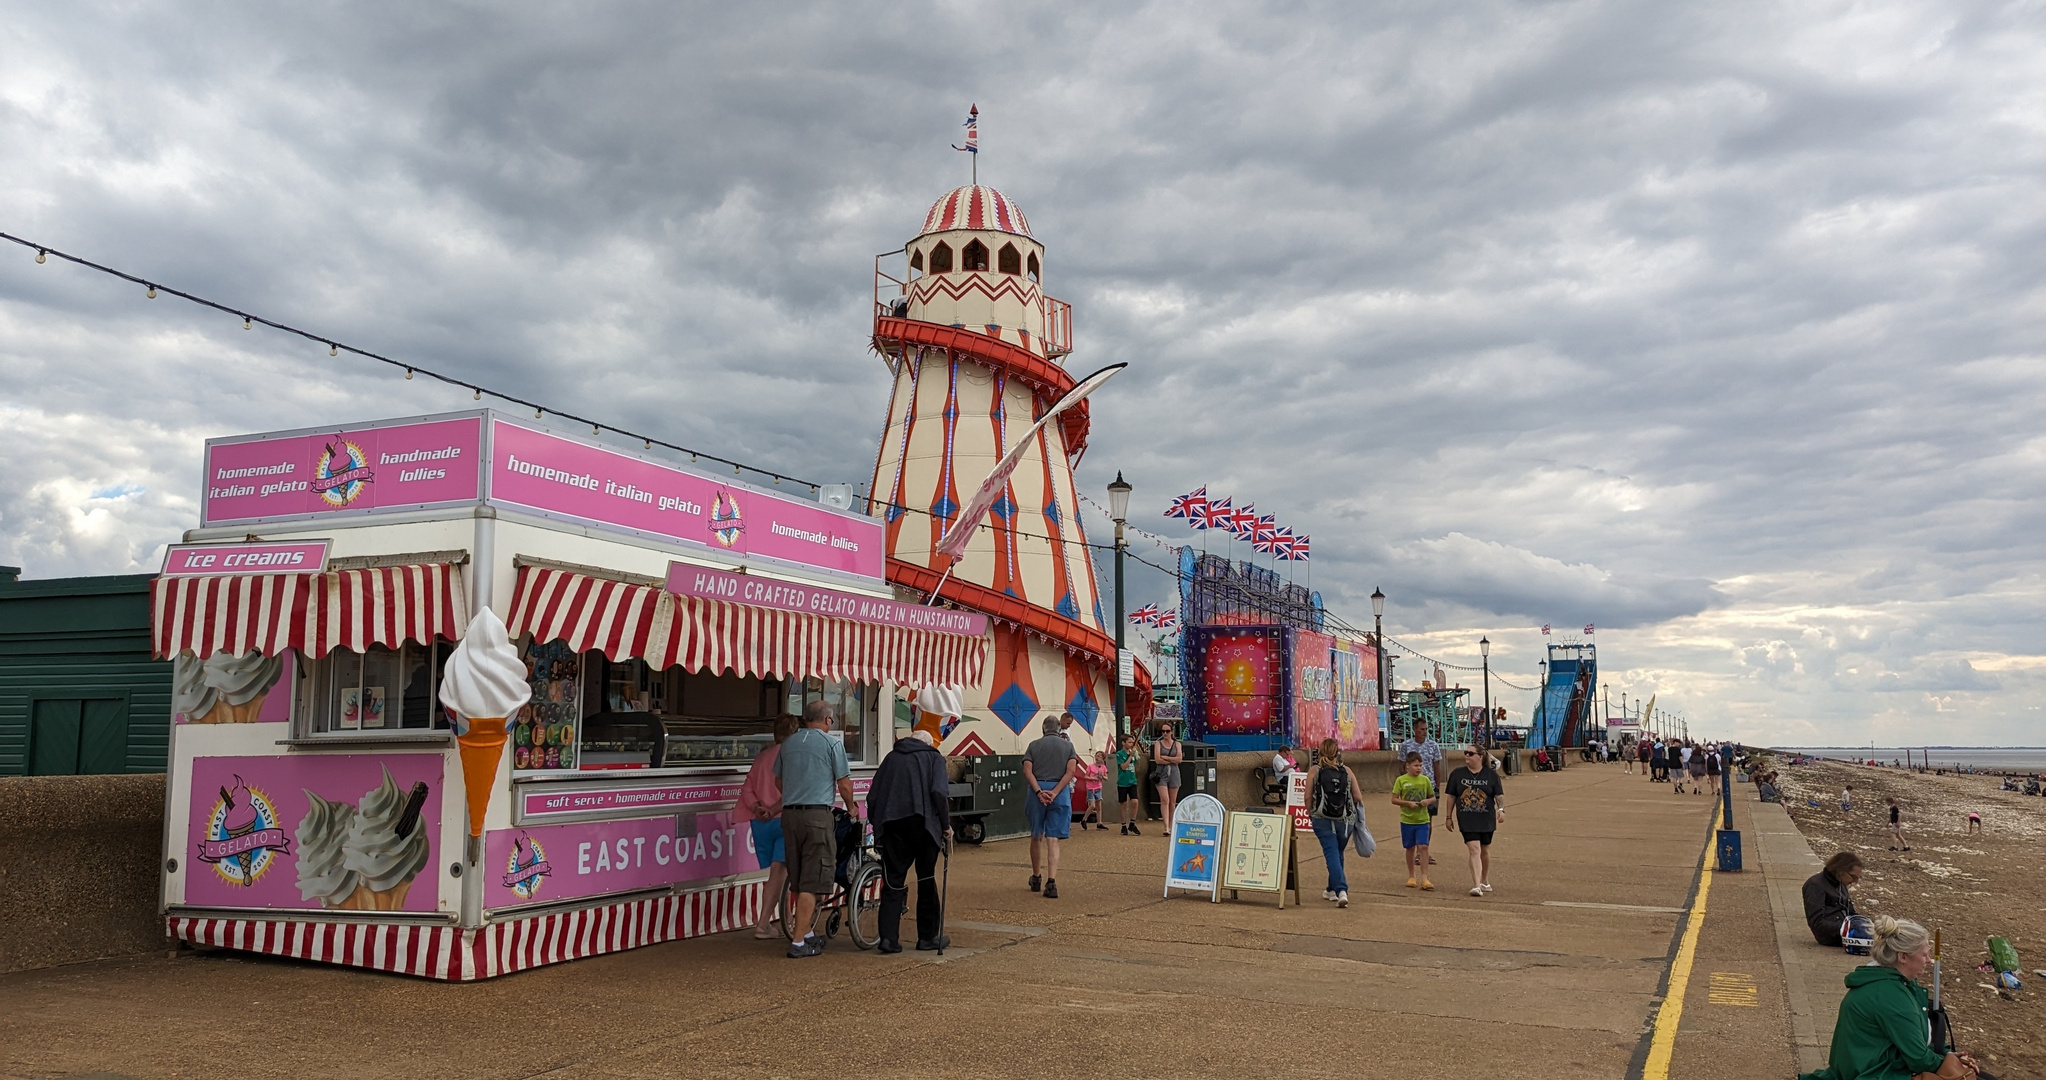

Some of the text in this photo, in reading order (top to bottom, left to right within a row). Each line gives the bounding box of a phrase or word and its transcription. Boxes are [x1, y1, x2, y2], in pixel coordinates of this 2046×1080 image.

[380, 445, 461, 465] handmade
[217, 462, 295, 480] homemade
[324, 469, 360, 488] GELATO
[399, 467, 446, 483] lollies
[209, 479, 307, 499] italian gelato
[507, 454, 599, 492] homemade
[604, 479, 653, 504] italian
[658, 494, 701, 517] gelato
[717, 519, 738, 529] GELATO
[771, 520, 860, 552] homemade lollies
[184, 550, 305, 568] ice creams
[694, 573, 971, 631] HAND CRAFTED GELATO MADE IN HUNSTANTON
[1461, 778, 1488, 787] QUEEN
[546, 787, 742, 808] soft serve homemade ice cream home
[212, 798, 273, 836] EAST COAST
[1295, 808, 1309, 817] NO
[1295, 818, 1313, 827] OPE
[218, 831, 268, 855] GELATO
[578, 837, 646, 875] EAST
[655, 828, 735, 866] COAST
[253, 854, 267, 871] 2016
[514, 864, 541, 881] GELATO
